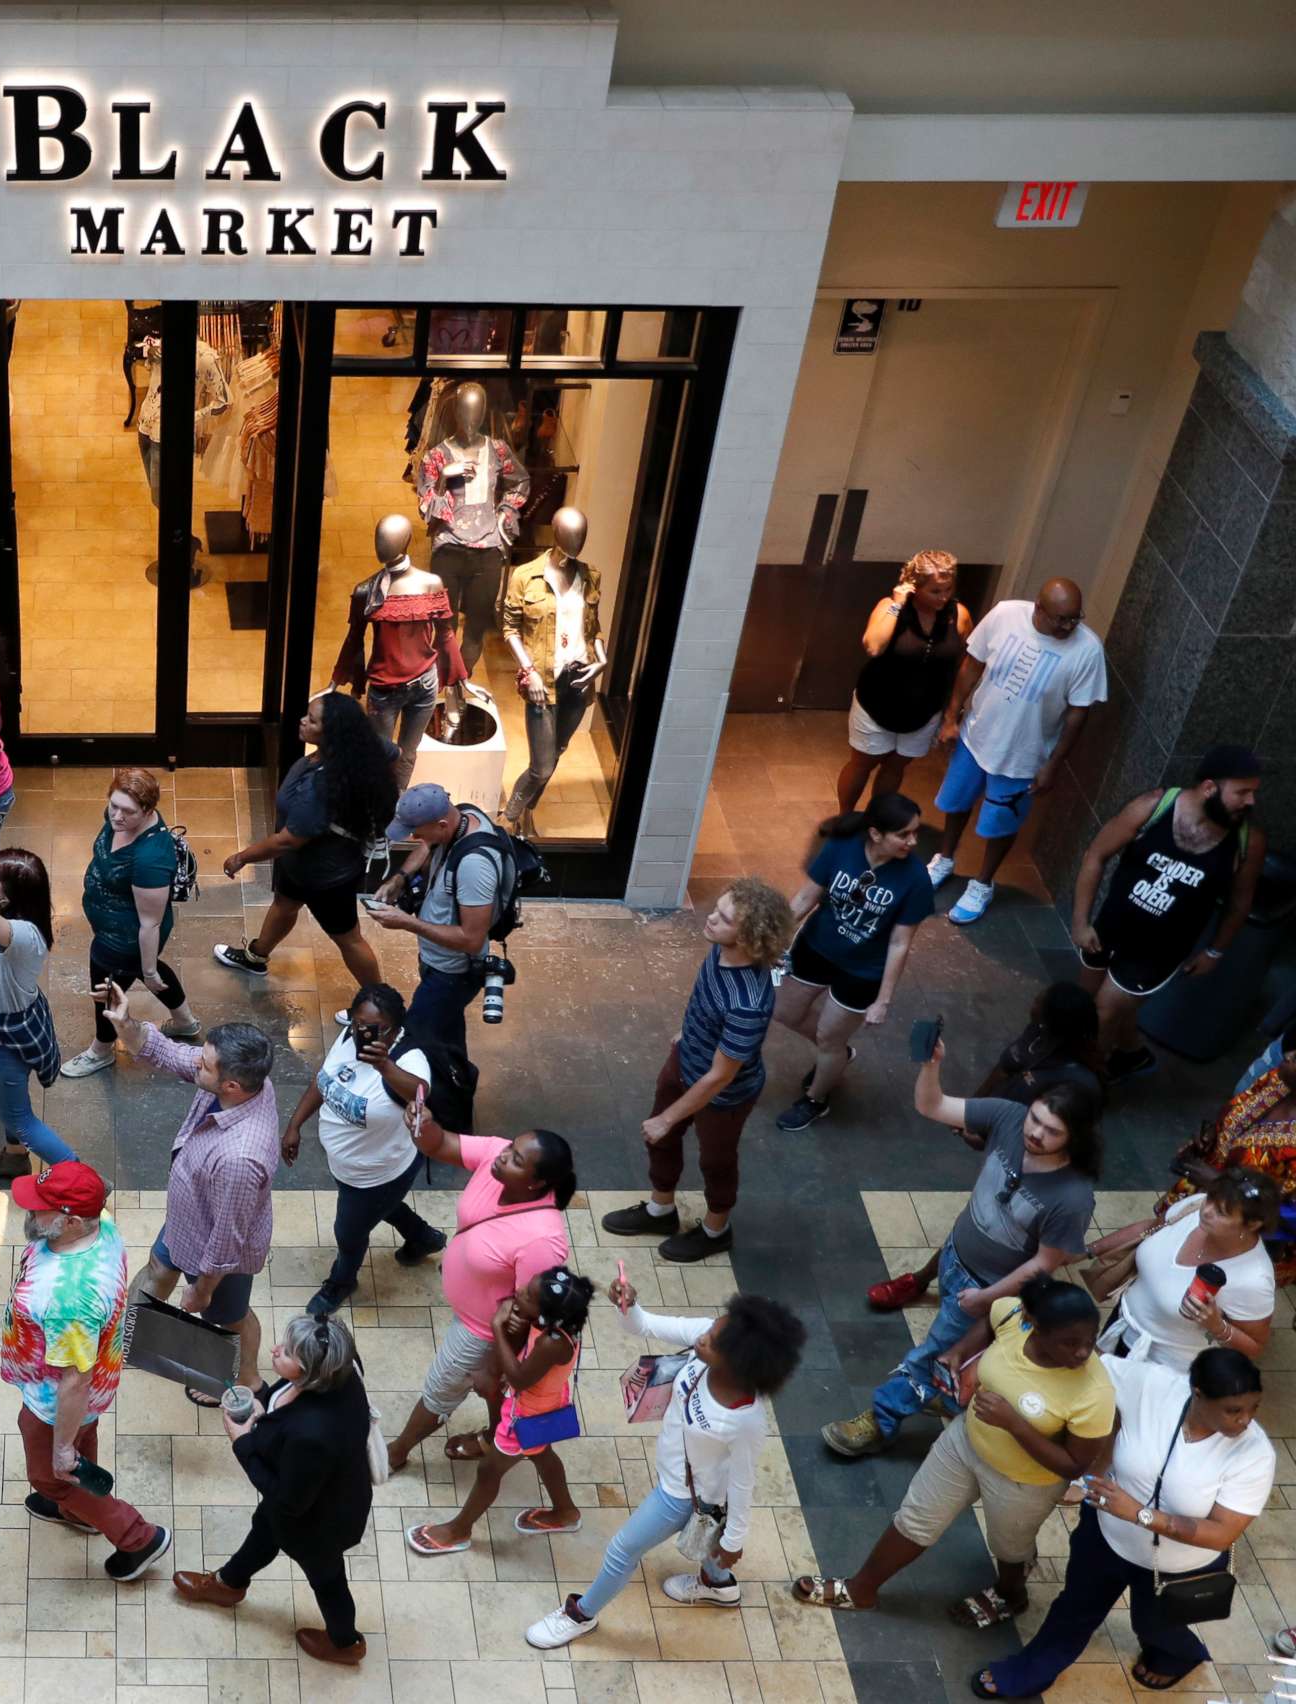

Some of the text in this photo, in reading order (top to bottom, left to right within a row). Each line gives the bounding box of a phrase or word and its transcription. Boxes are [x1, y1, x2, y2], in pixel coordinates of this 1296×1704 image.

[3, 85, 507, 181] BLACK
[1016, 182, 1078, 221] EXIT
[70, 207, 438, 256] MARKET
[1146, 852, 1205, 888] GENDER
[1153, 872, 1174, 891] IS
